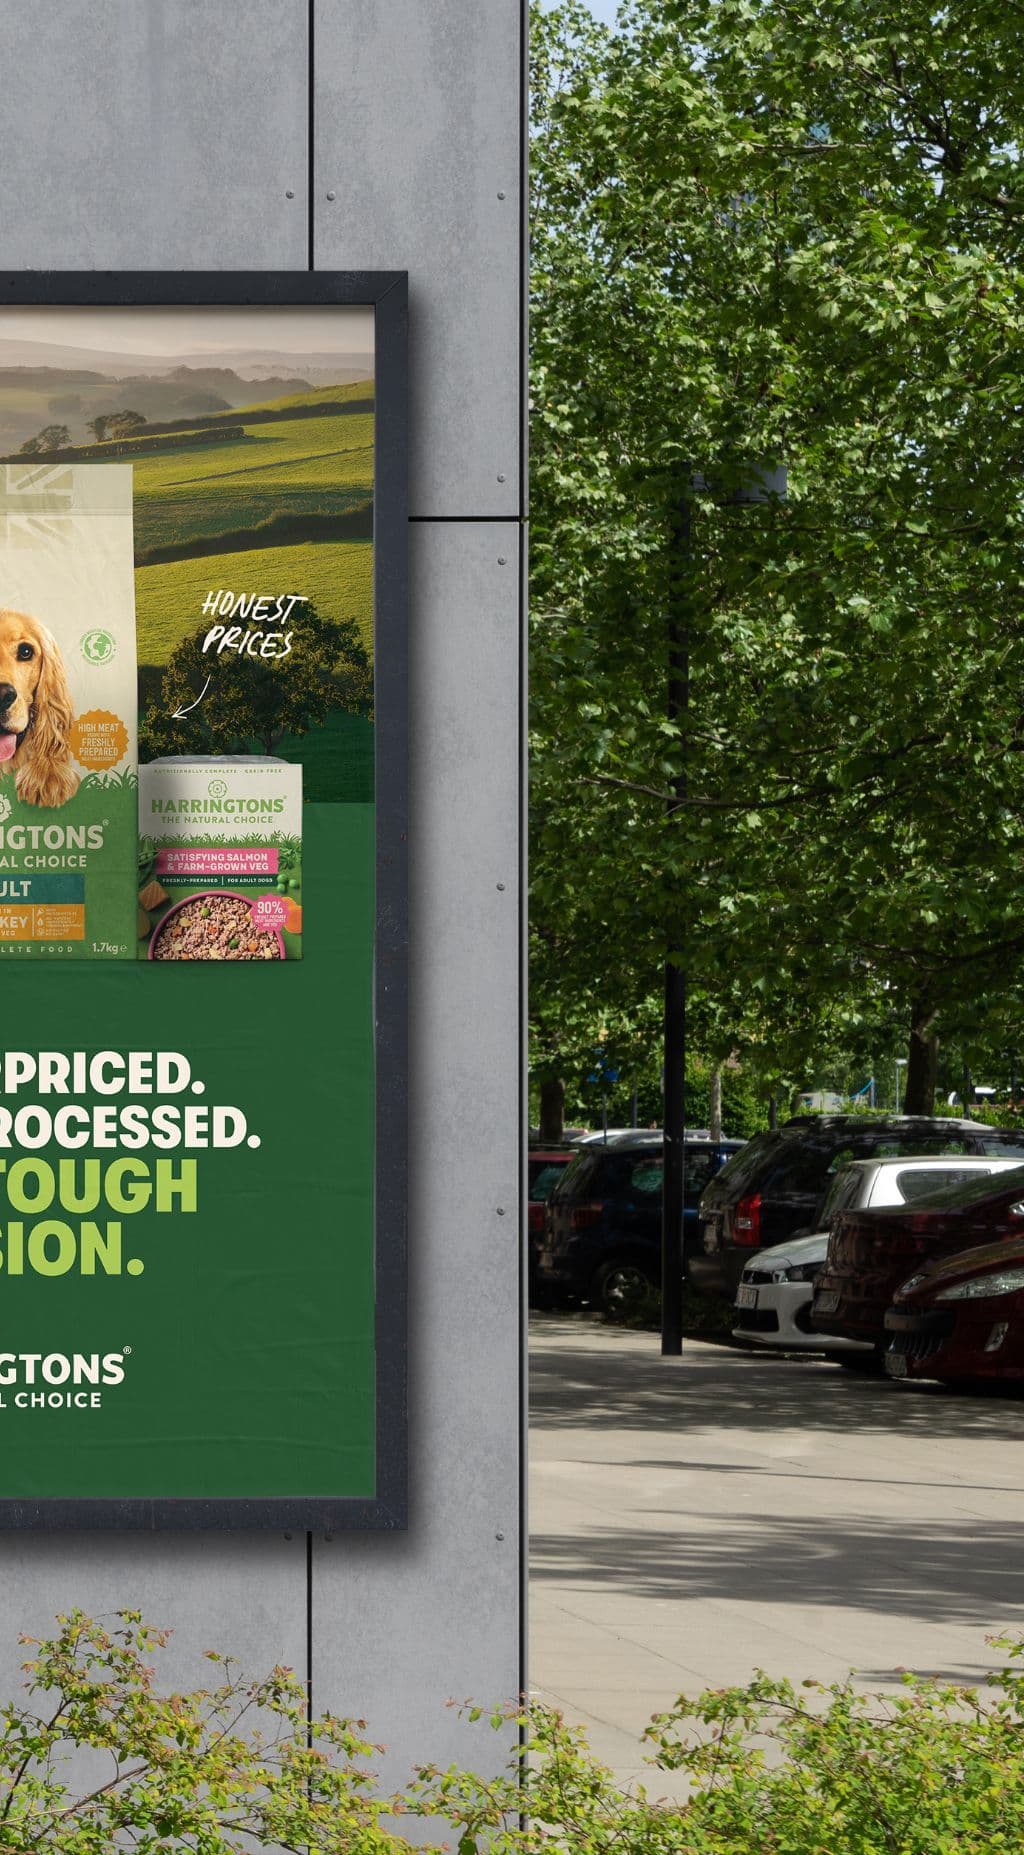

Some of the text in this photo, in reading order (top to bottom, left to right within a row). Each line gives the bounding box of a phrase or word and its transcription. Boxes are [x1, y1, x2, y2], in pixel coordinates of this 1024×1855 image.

[201, 590, 308, 624] HONEST
[201, 625, 294, 659] PRICES
[78, 723, 119, 733] HIGH MEAT
[81, 738, 116, 747] FRESHLY
[79, 747, 118, 756] PREPARED
[161, 815, 274, 824] THE NATURAL CHOICE
[23, 855, 88, 868] CHOICE
[167, 853, 268, 862] SATISFYING SALMON
[167, 862, 269, 871] & FARM-GROWN VEG
[257, 901, 284, 914] 90%
[92, 942, 118, 955] 1.7kg
[13, 1392, 102, 1409] CHOICE
